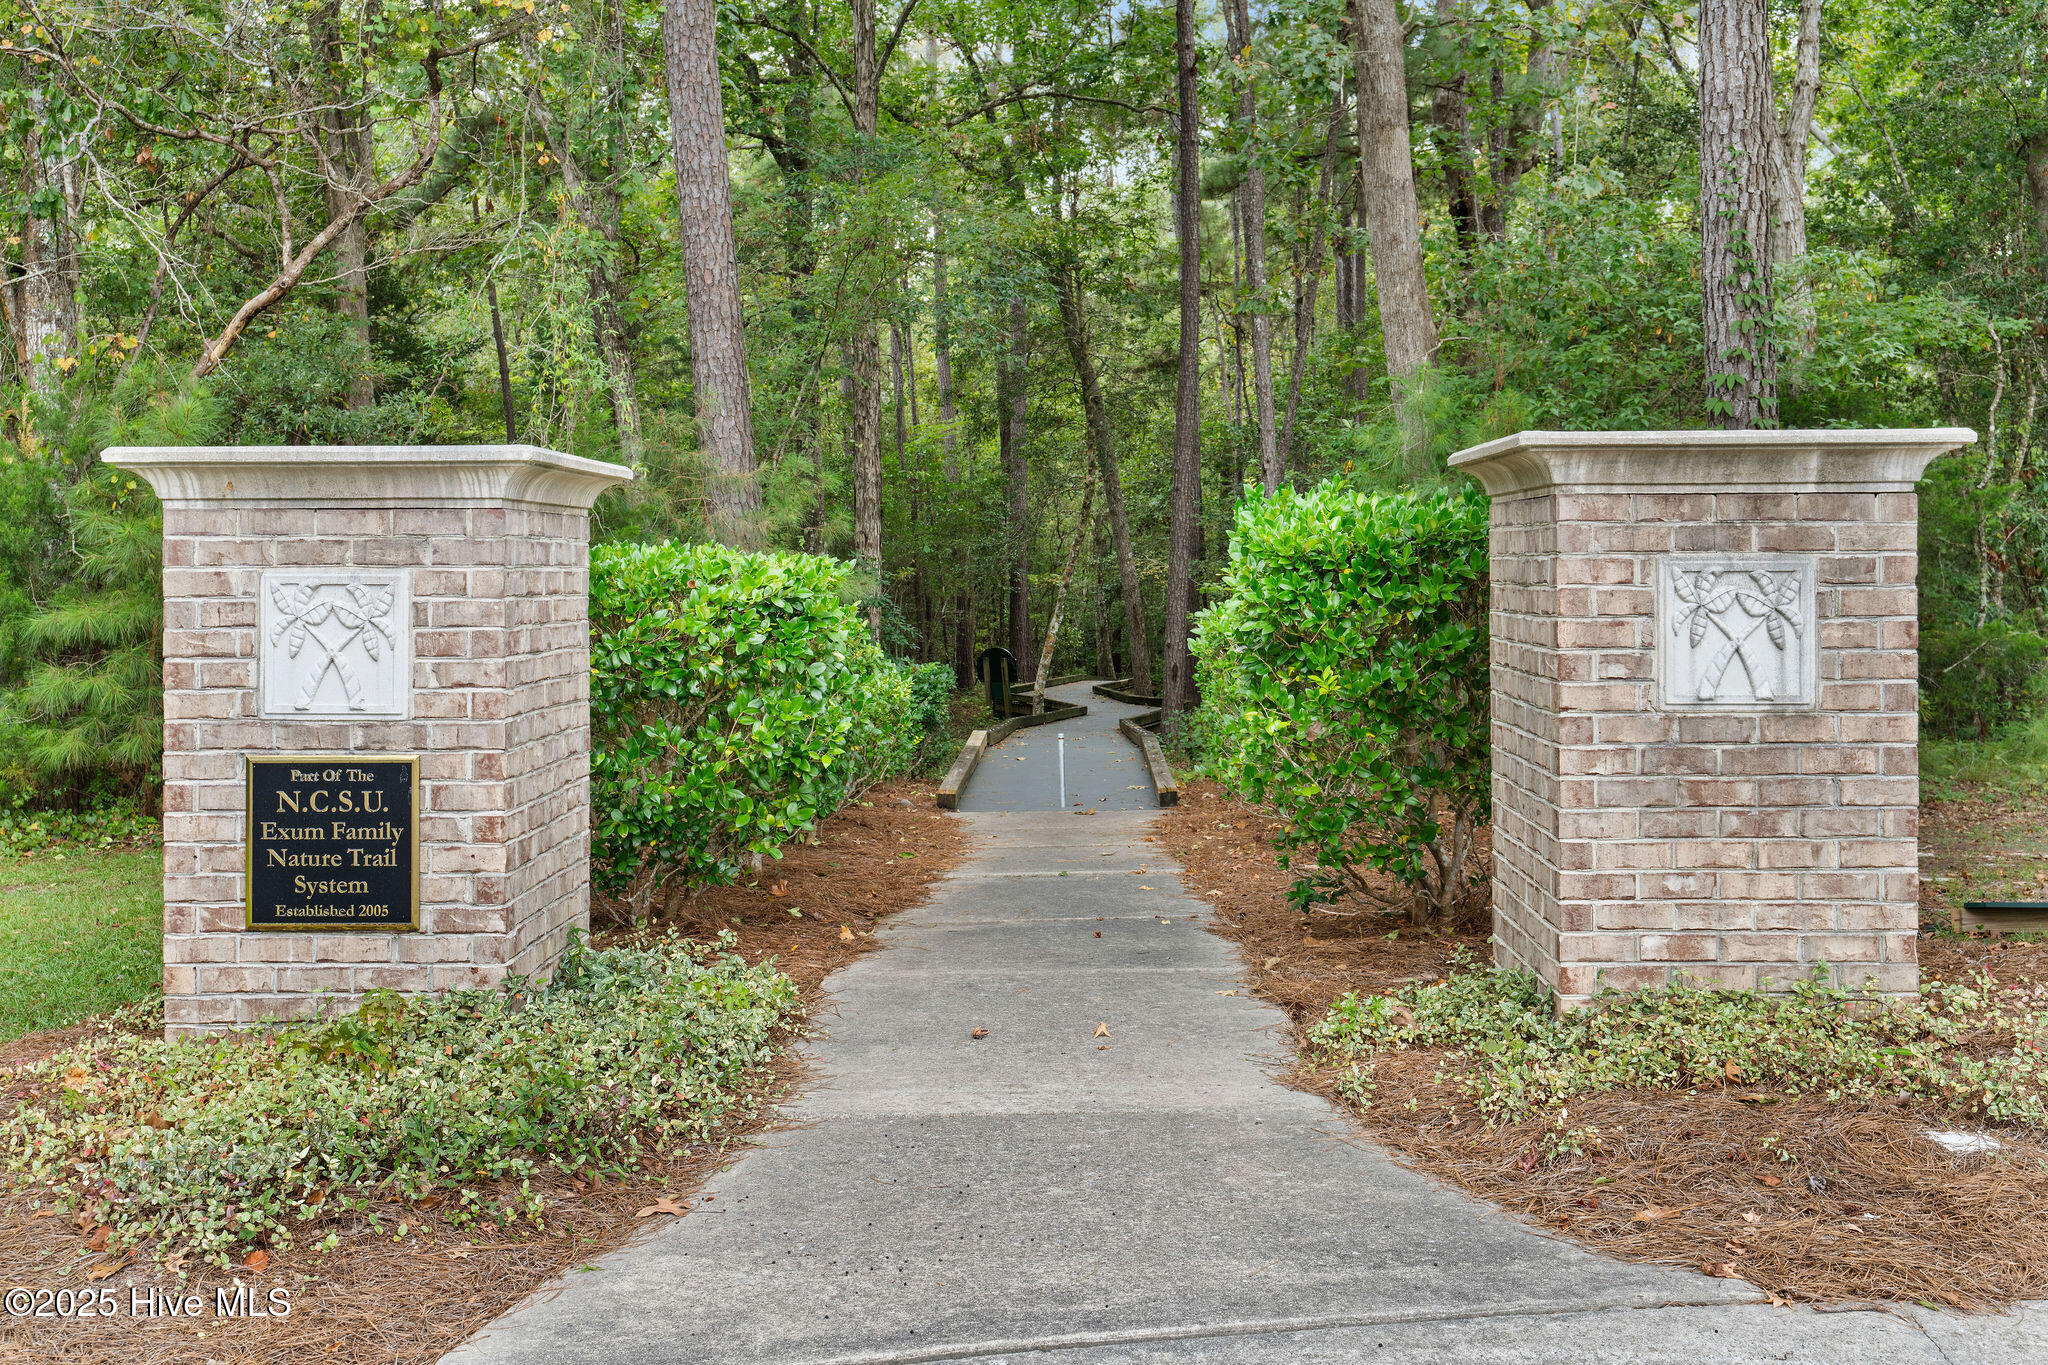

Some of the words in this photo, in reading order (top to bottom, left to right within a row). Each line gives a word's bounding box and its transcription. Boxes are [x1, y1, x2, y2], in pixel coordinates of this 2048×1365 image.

[290, 769, 320, 782] Part
[322, 769, 342, 782] Of
[345, 769, 375, 782] The
[276, 790, 389, 813] N.C.S.U.
[260, 821, 325, 840] Exum
[331, 821, 404, 846] Family
[267, 848, 342, 867] Nature
[346, 848, 398, 867] Trail
[294, 875, 369, 900] System
[275, 904, 355, 917] Established
[358, 904, 389, 917] 2005
